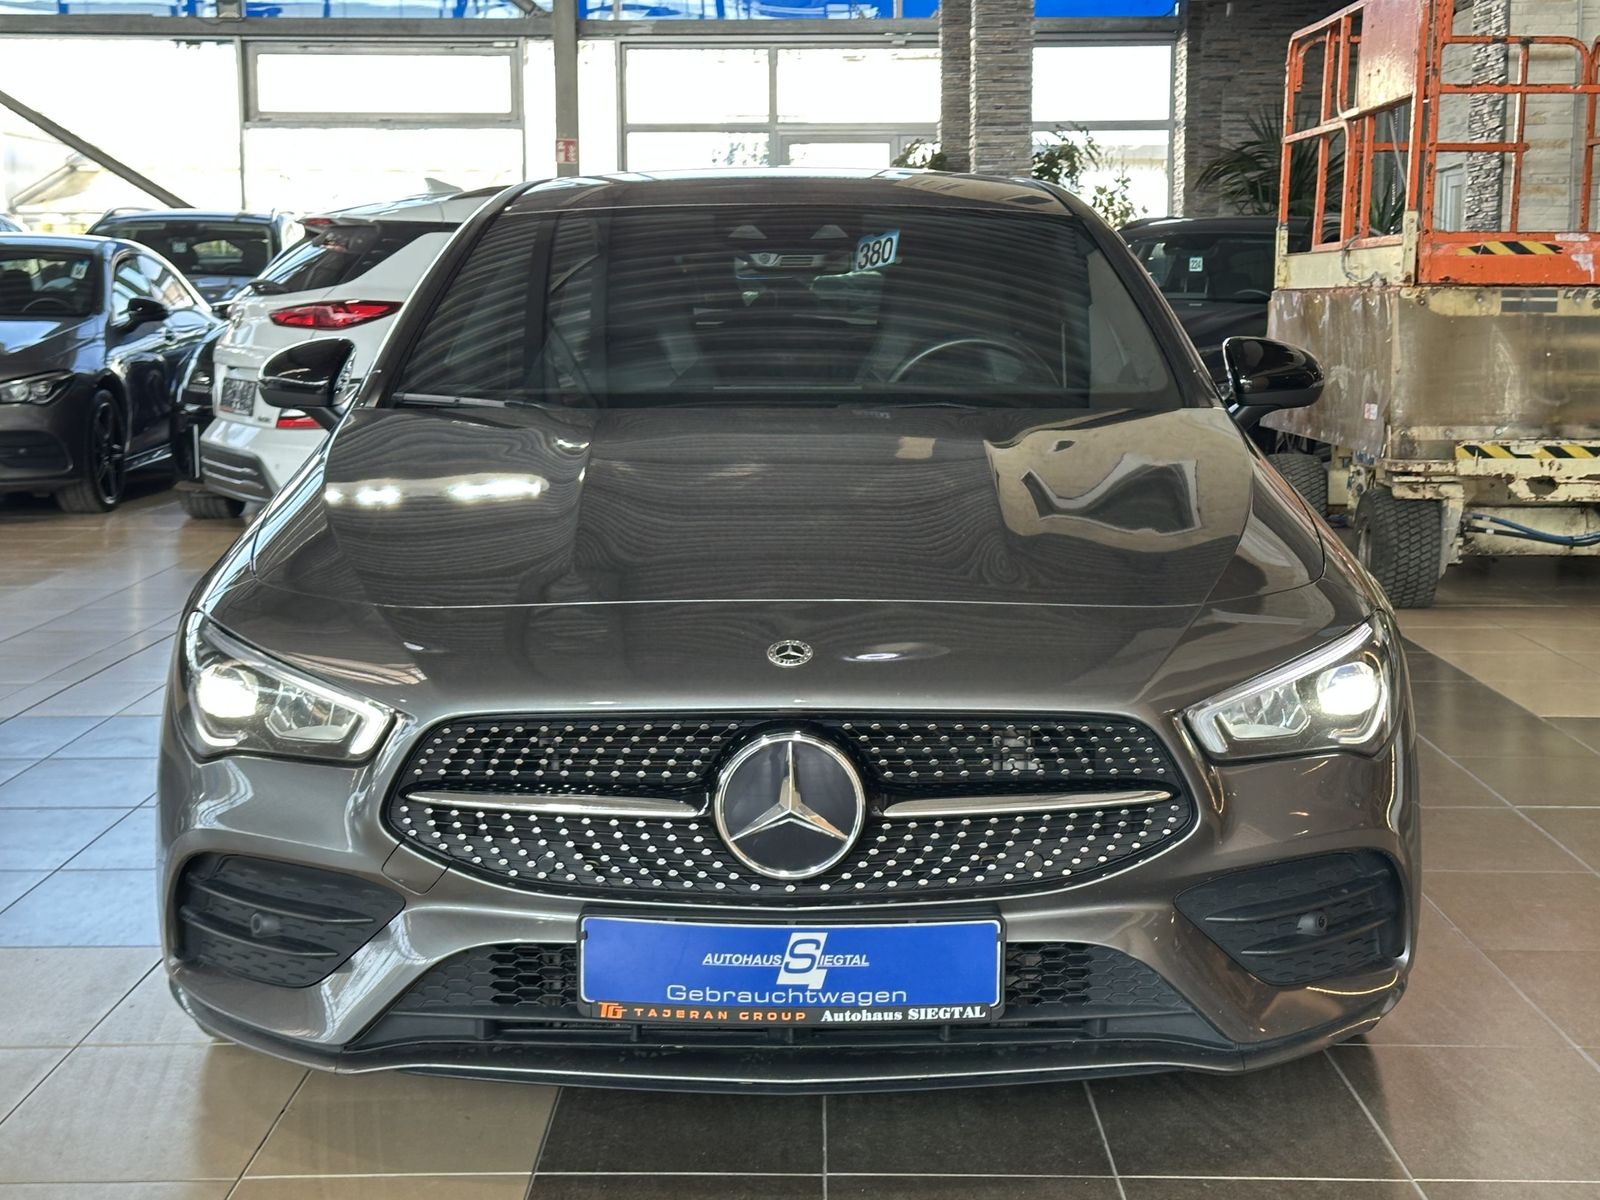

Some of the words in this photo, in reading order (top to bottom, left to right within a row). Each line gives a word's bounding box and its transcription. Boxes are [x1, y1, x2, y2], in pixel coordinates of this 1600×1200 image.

[858, 237, 893, 269] 380
[702, 953, 782, 966] AUTOHAUS
[666, 984, 907, 1007] Gebrauchtwagen
[634, 1007, 728, 1020] TAJERAN
[739, 1011, 806, 1021] GROUP
[821, 1009, 903, 1022] Autohaus
[908, 1006, 986, 1020] SIEGTAL
